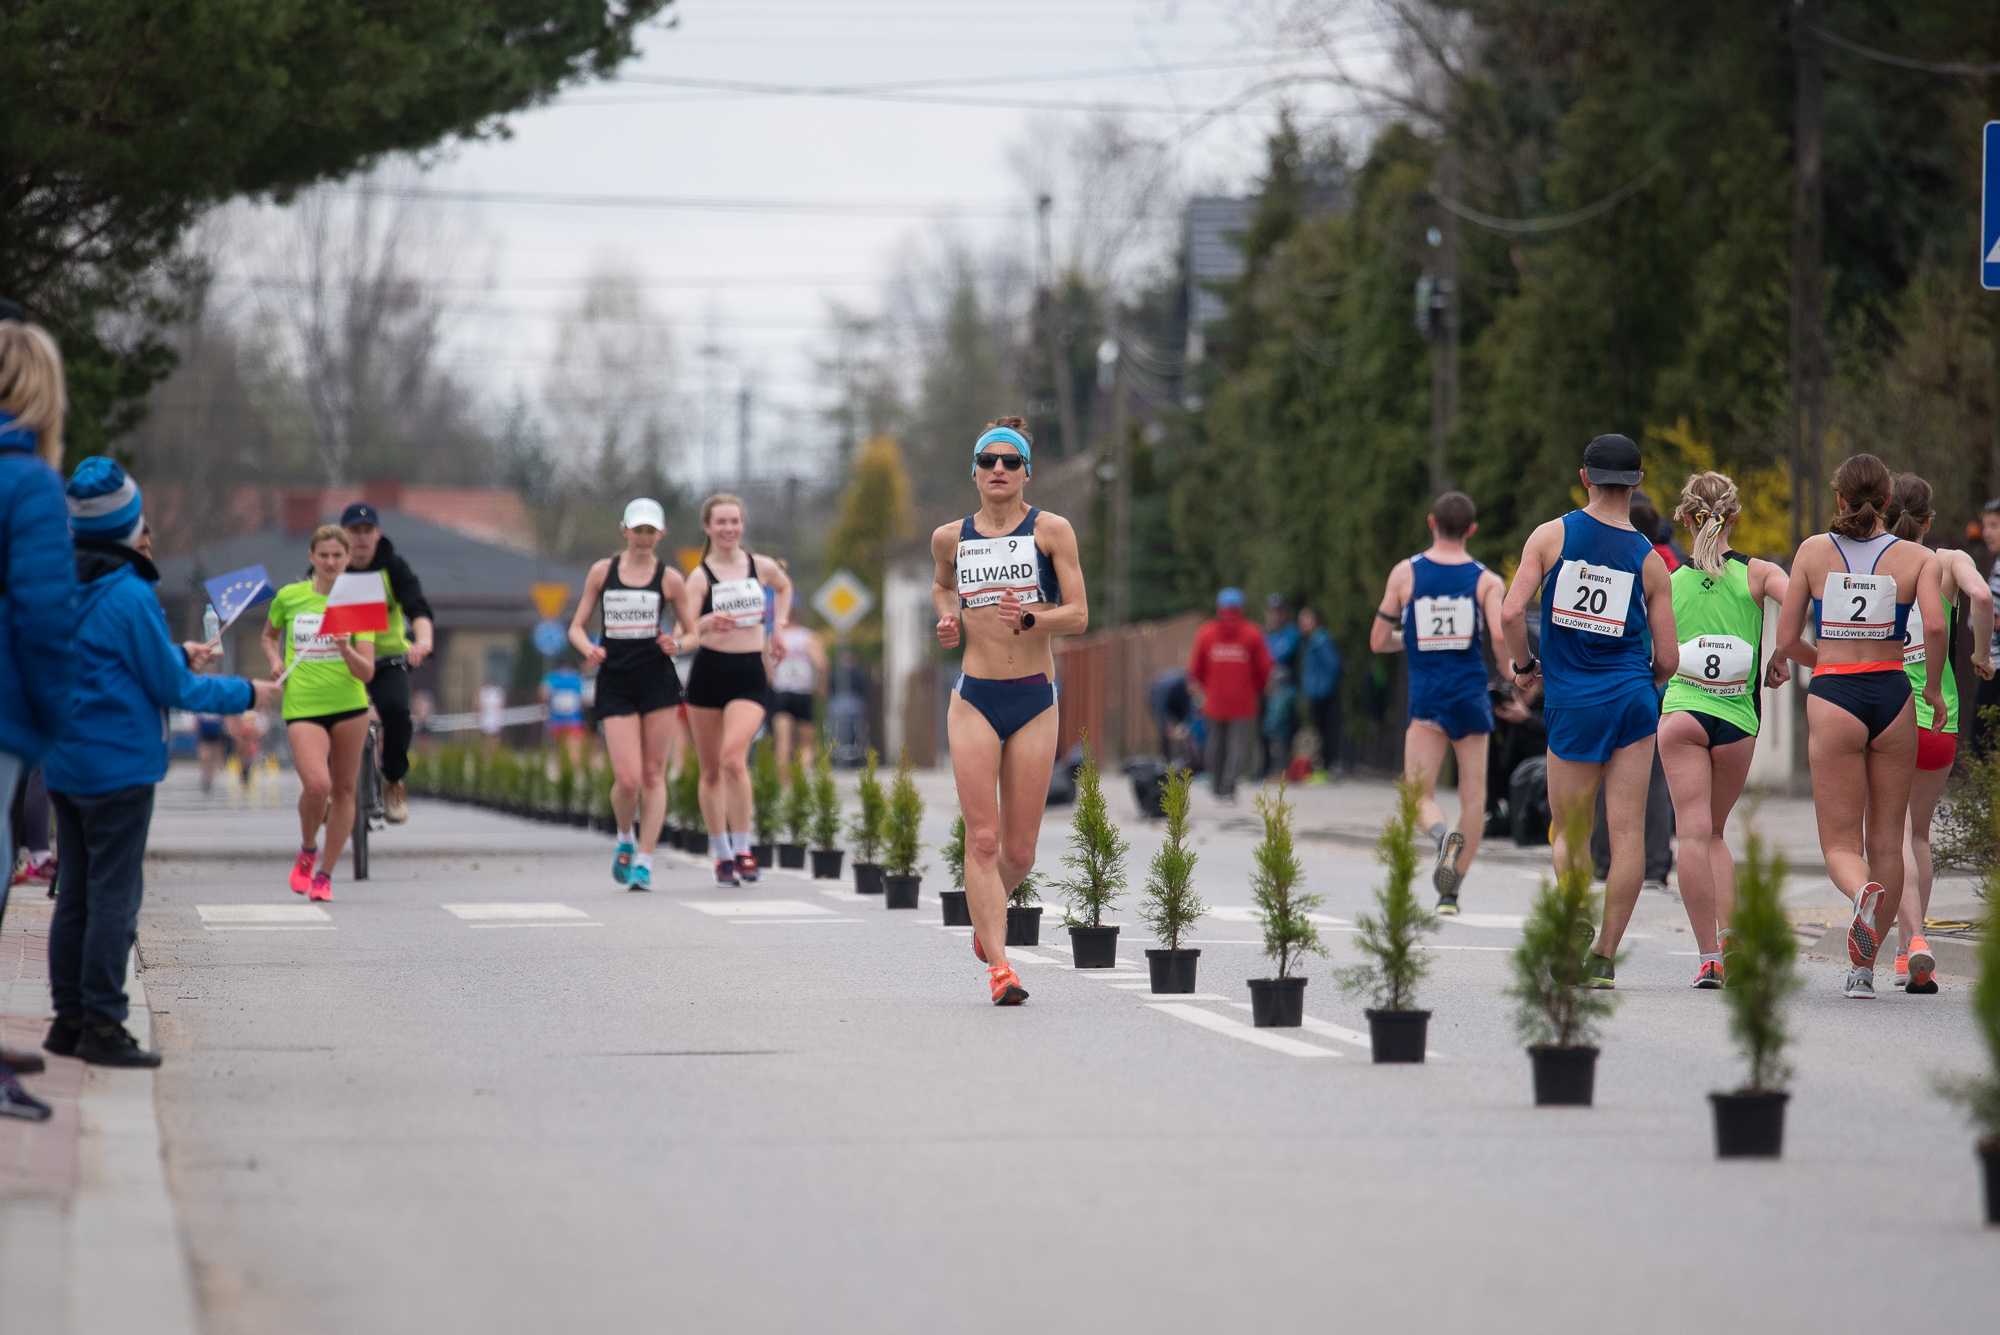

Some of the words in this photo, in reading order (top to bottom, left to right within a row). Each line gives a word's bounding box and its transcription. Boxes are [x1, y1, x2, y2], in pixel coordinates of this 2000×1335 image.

[1008, 540, 1018, 553] 9
[961, 563, 1033, 584] ELLWARD
[968, 594, 1000, 606] ULEJÓWE
[1573, 585, 1608, 615] 20
[1850, 596, 1867, 622] 2
[1432, 617, 1456, 636] 21
[1554, 616, 1592, 629] SULEJÓWEK
[1594, 624, 1611, 633] 2022
[1825, 629, 1866, 637] SULEJÓWEK
[1704, 654, 1721, 680] 8
